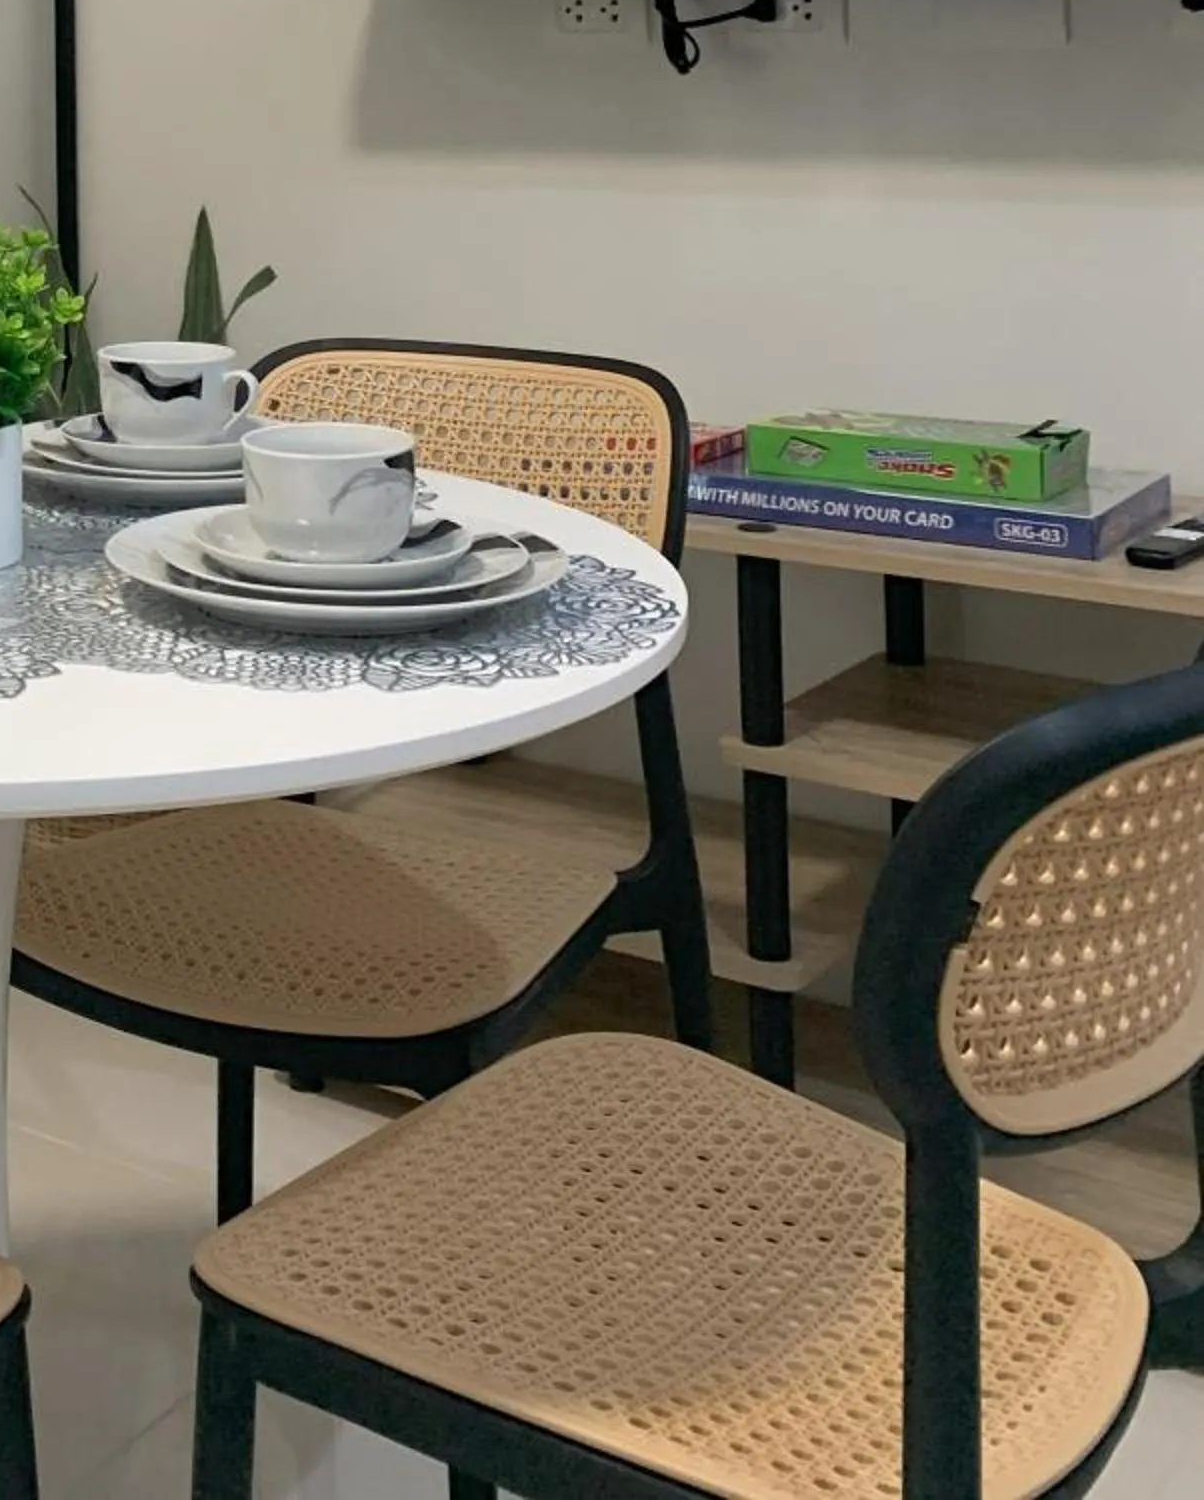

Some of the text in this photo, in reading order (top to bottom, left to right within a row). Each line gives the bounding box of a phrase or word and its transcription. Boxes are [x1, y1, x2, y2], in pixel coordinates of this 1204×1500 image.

[741, 491, 819, 514] MILLIONS
[823, 500, 849, 518] ON
[852, 503, 900, 525] YOUR
[904, 510, 956, 530] CARD
[1001, 522, 1062, 543] SKG-03
